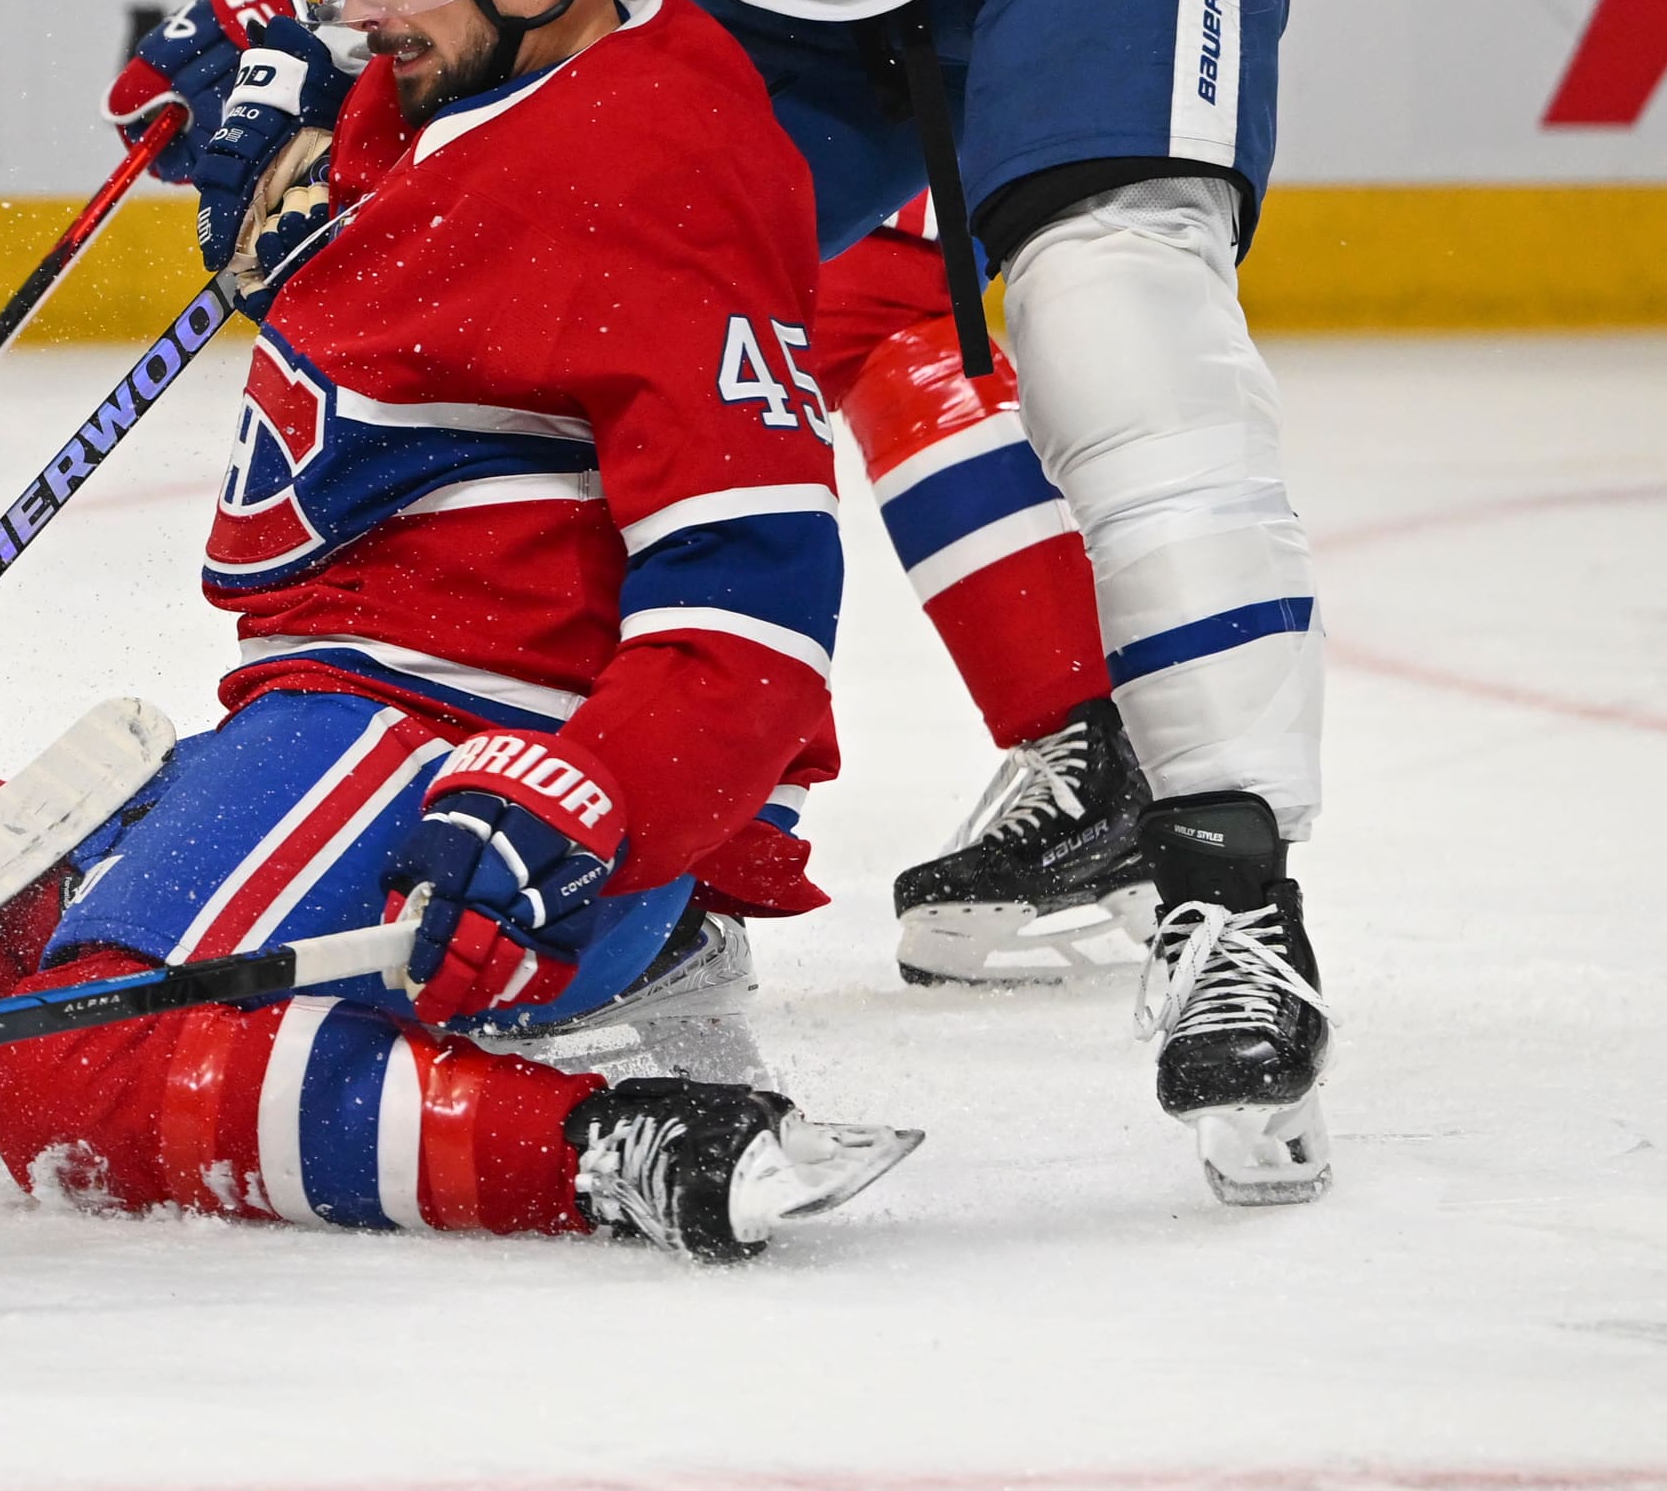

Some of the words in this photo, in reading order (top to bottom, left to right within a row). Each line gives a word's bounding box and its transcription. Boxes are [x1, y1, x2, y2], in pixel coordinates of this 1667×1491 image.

[716, 313, 834, 446] 45
[437, 734, 614, 830] RRIOR
[1041, 818, 1110, 868] BAUER
[1196, 829, 1224, 843] STYLES
[559, 866, 604, 898] COVERT
[63, 993, 122, 1013] ALPHA
